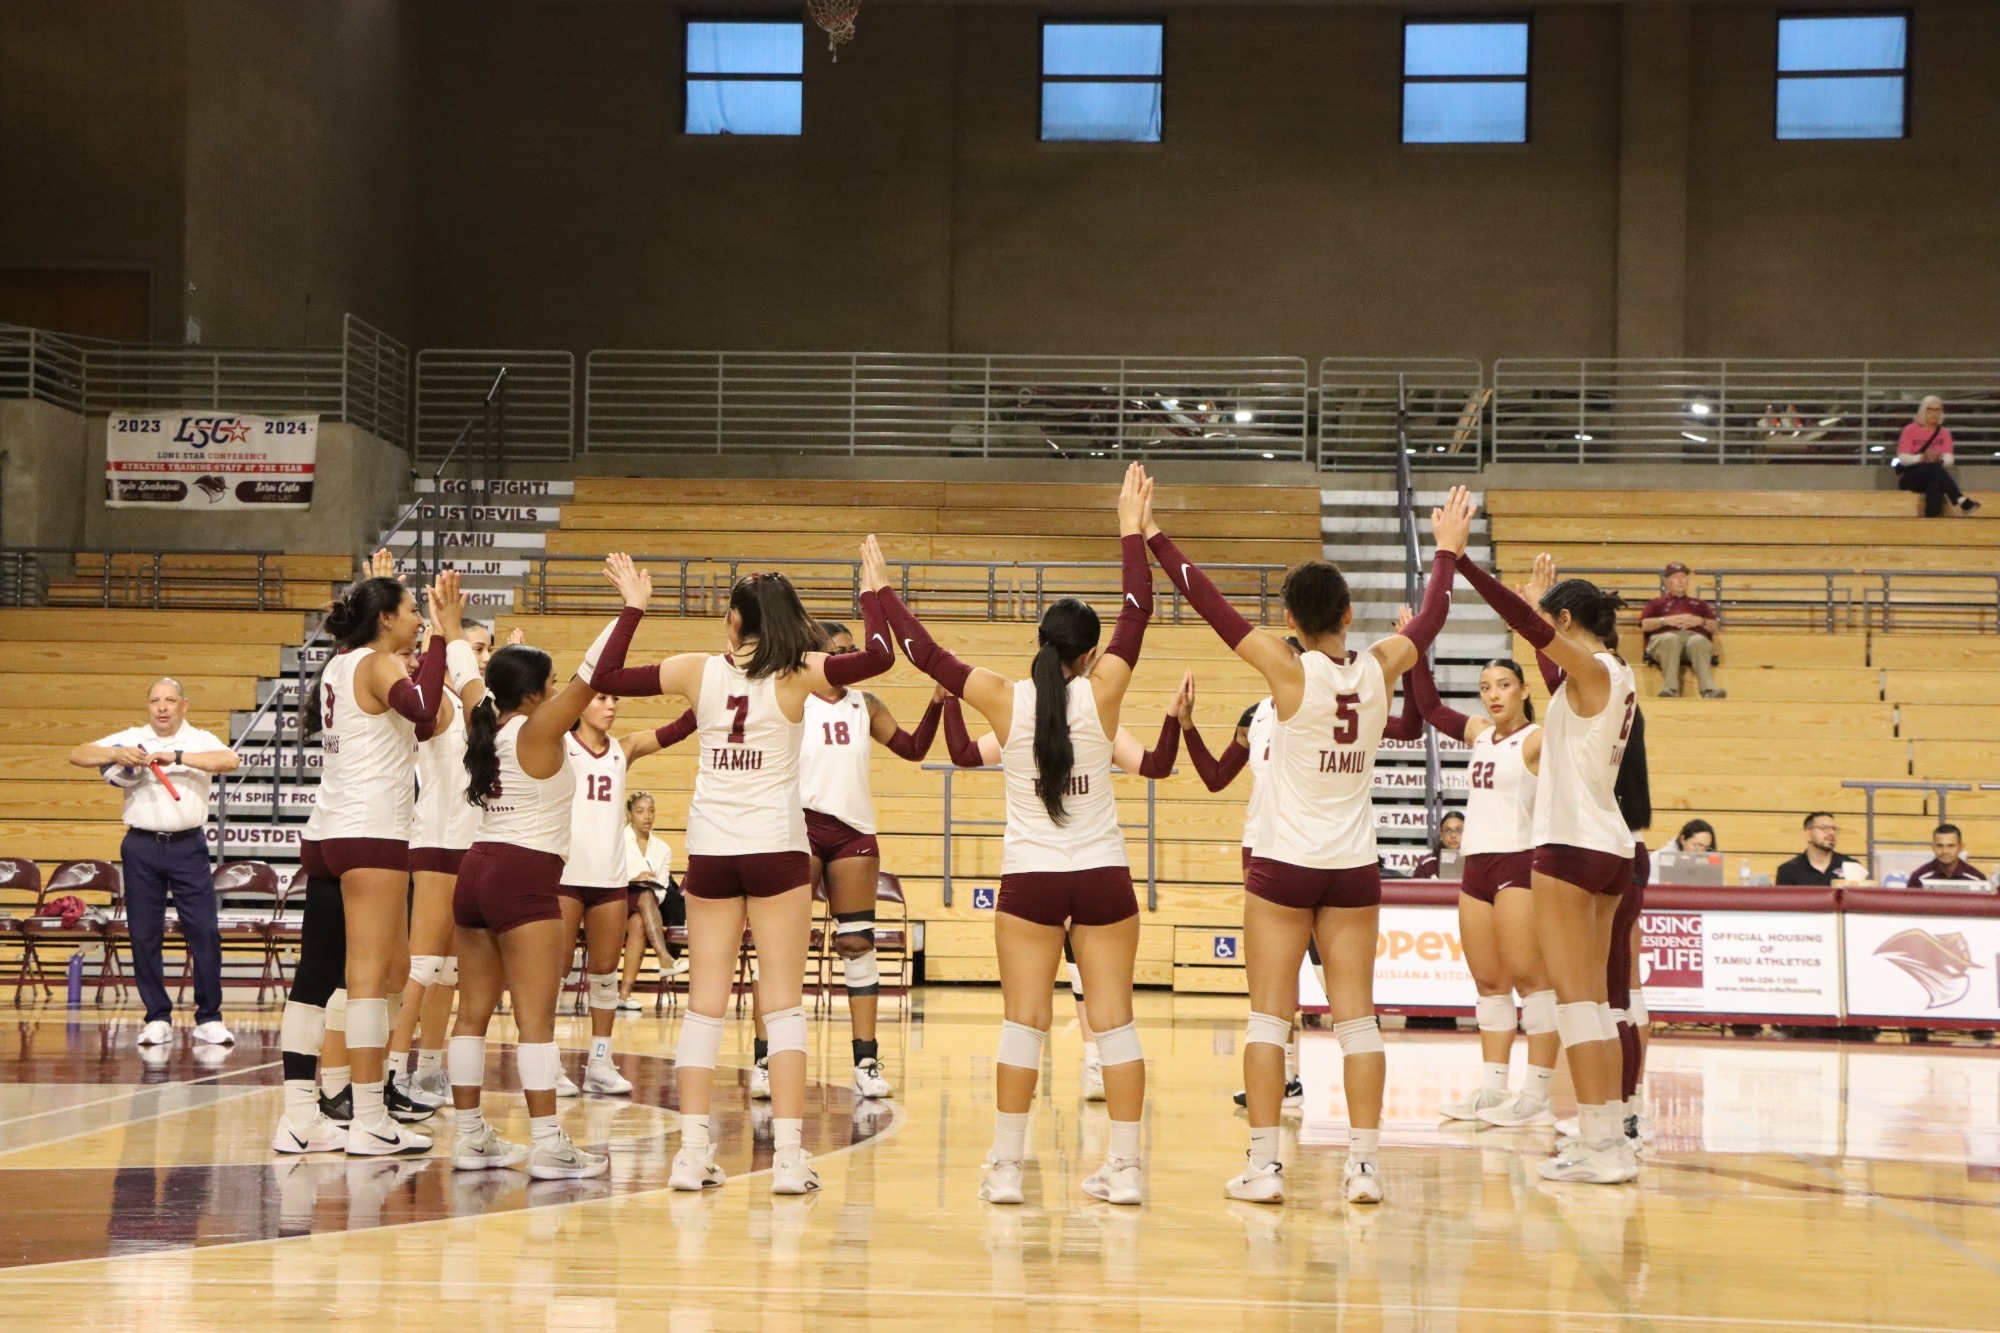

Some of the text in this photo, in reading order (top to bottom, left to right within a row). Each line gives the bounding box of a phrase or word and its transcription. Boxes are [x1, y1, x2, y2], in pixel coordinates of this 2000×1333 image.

[118, 420, 161, 432] 2023
[173, 417, 235, 448] LSC
[265, 422, 307, 434] 2024
[168, 463, 211, 471] TRAINING
[489, 481, 549, 494] FIGHT!
[438, 533, 495, 547] TAMIU
[726, 695, 749, 743] 7
[1333, 693, 1361, 744] 5
[822, 721, 850, 745] 18
[712, 748, 763, 770] TAMIU
[1318, 750, 1365, 774] TAMIU
[1471, 761, 1496, 789] 22
[587, 774, 612, 802] 12
[246, 792, 287, 803] SPIRT
[1711, 932, 1823, 943] OFFICIAL HOUSING
[1760, 945, 1775, 954] OF
[1653, 948, 1703, 971] LIFE
[1714, 956, 1822, 967] TAMIU ATHLETICS
